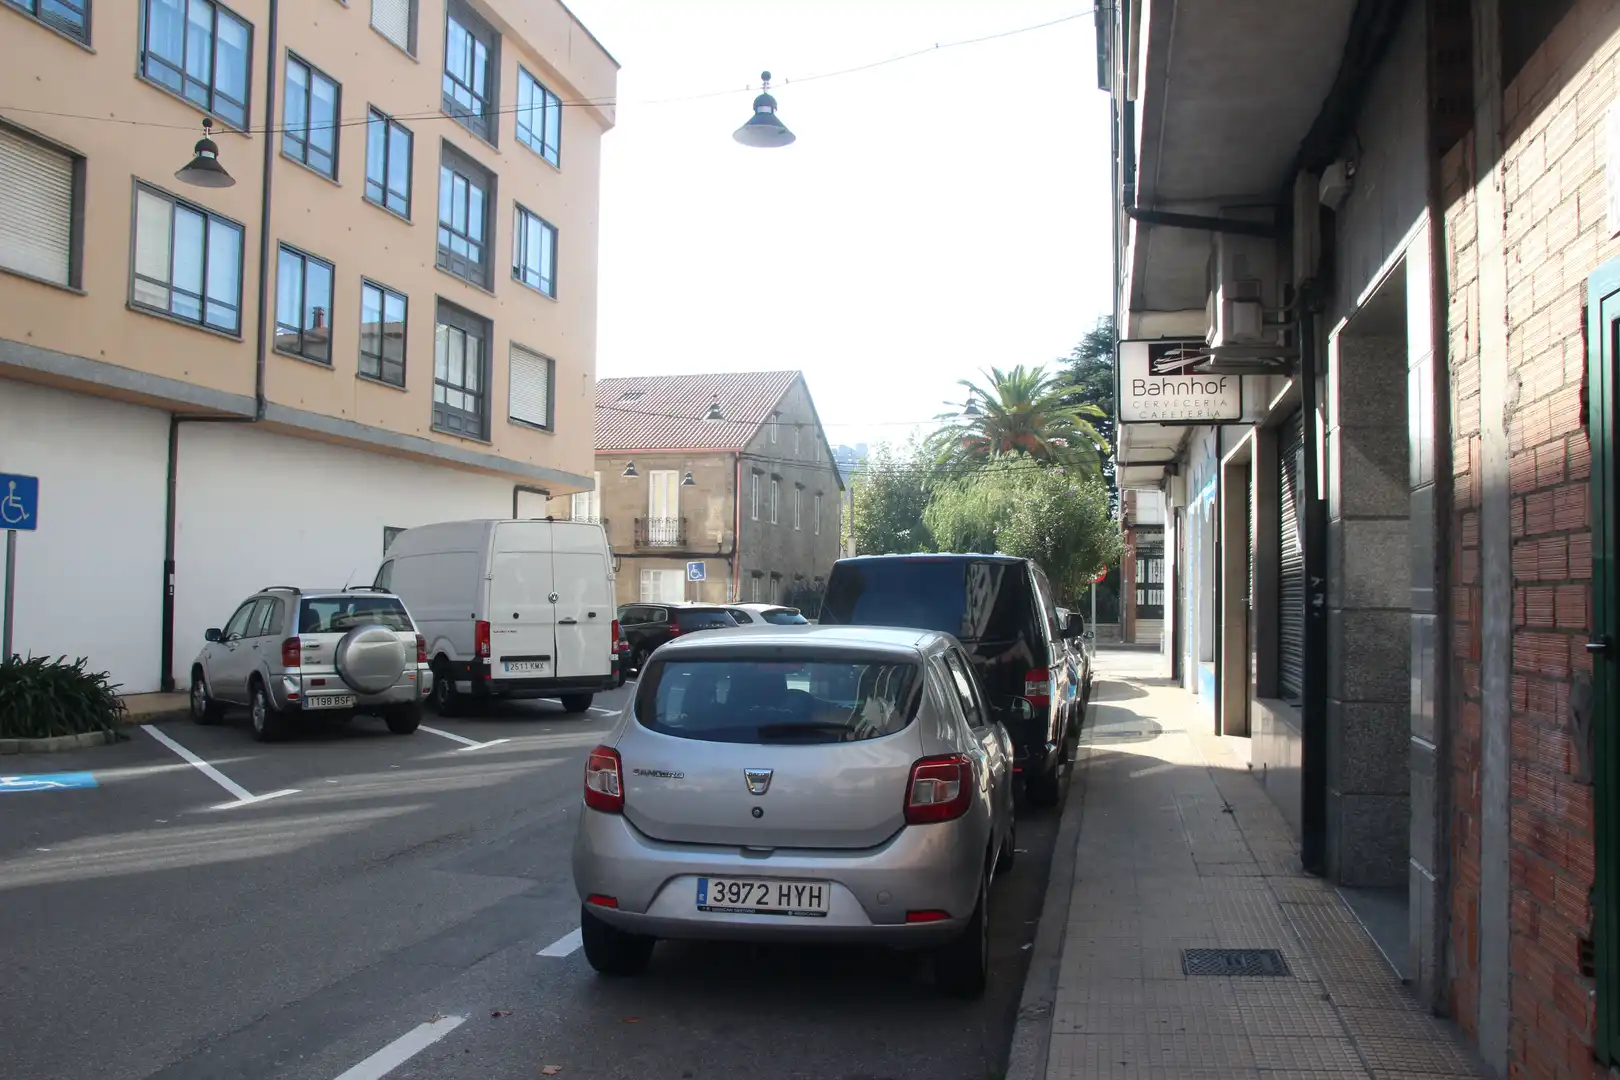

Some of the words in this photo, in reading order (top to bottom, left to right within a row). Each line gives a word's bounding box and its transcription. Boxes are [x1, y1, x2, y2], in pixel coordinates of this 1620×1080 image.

[1132, 376, 1228, 397] Bahnhof
[510, 662, 529, 671] 2511
[530, 662, 544, 670] KMX
[310, 697, 332, 706] 1198
[334, 696, 351, 705] BSF
[713, 881, 770, 906] 3972
[778, 884, 822, 908] HYH
